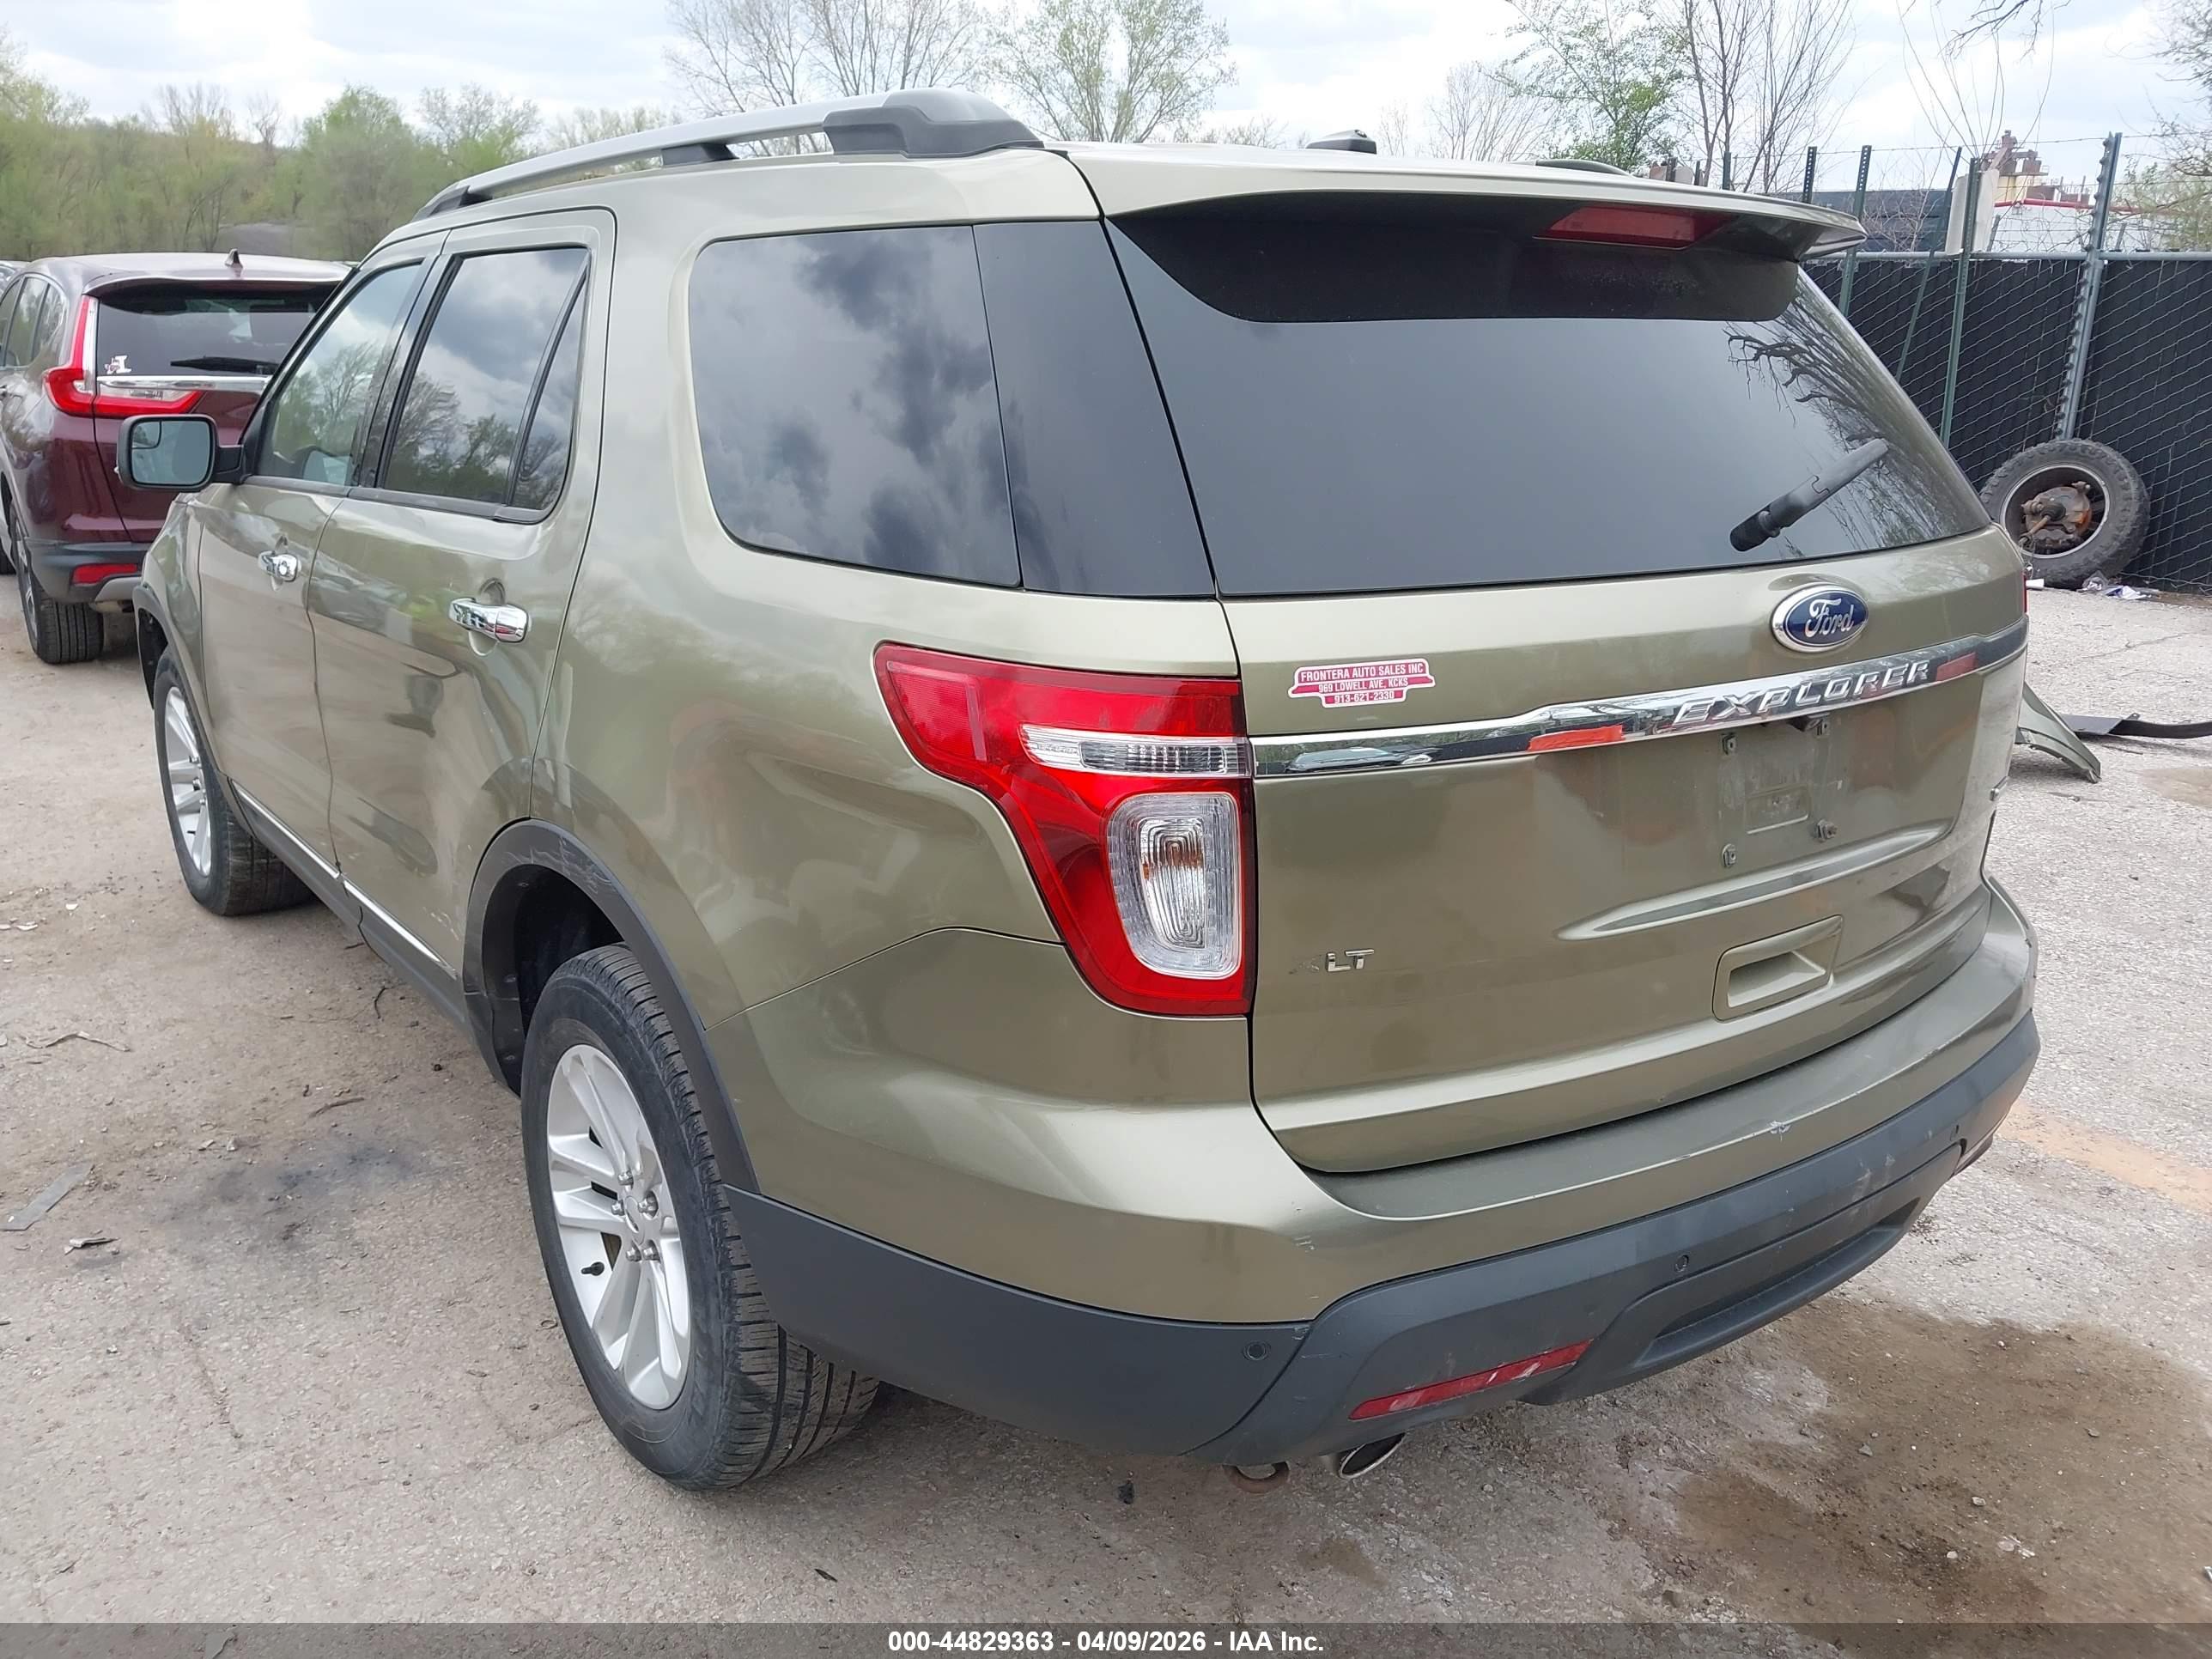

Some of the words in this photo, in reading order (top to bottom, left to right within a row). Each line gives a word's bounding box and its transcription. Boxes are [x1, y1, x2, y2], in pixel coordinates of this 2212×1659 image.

[1804, 598, 1855, 638] Ford
[1301, 669, 1349, 682] FRONTERA
[1352, 666, 1376, 678] AUTO
[1378, 665, 1406, 676] SALES
[1408, 663, 1424, 673] INC
[1318, 684, 1334, 693] 969
[1334, 681, 1367, 692] LOWELL
[1388, 678, 1408, 687] KCKS
[1672, 660, 1929, 726] EXPLORER
[1334, 691, 1395, 703] 913-621-2330
